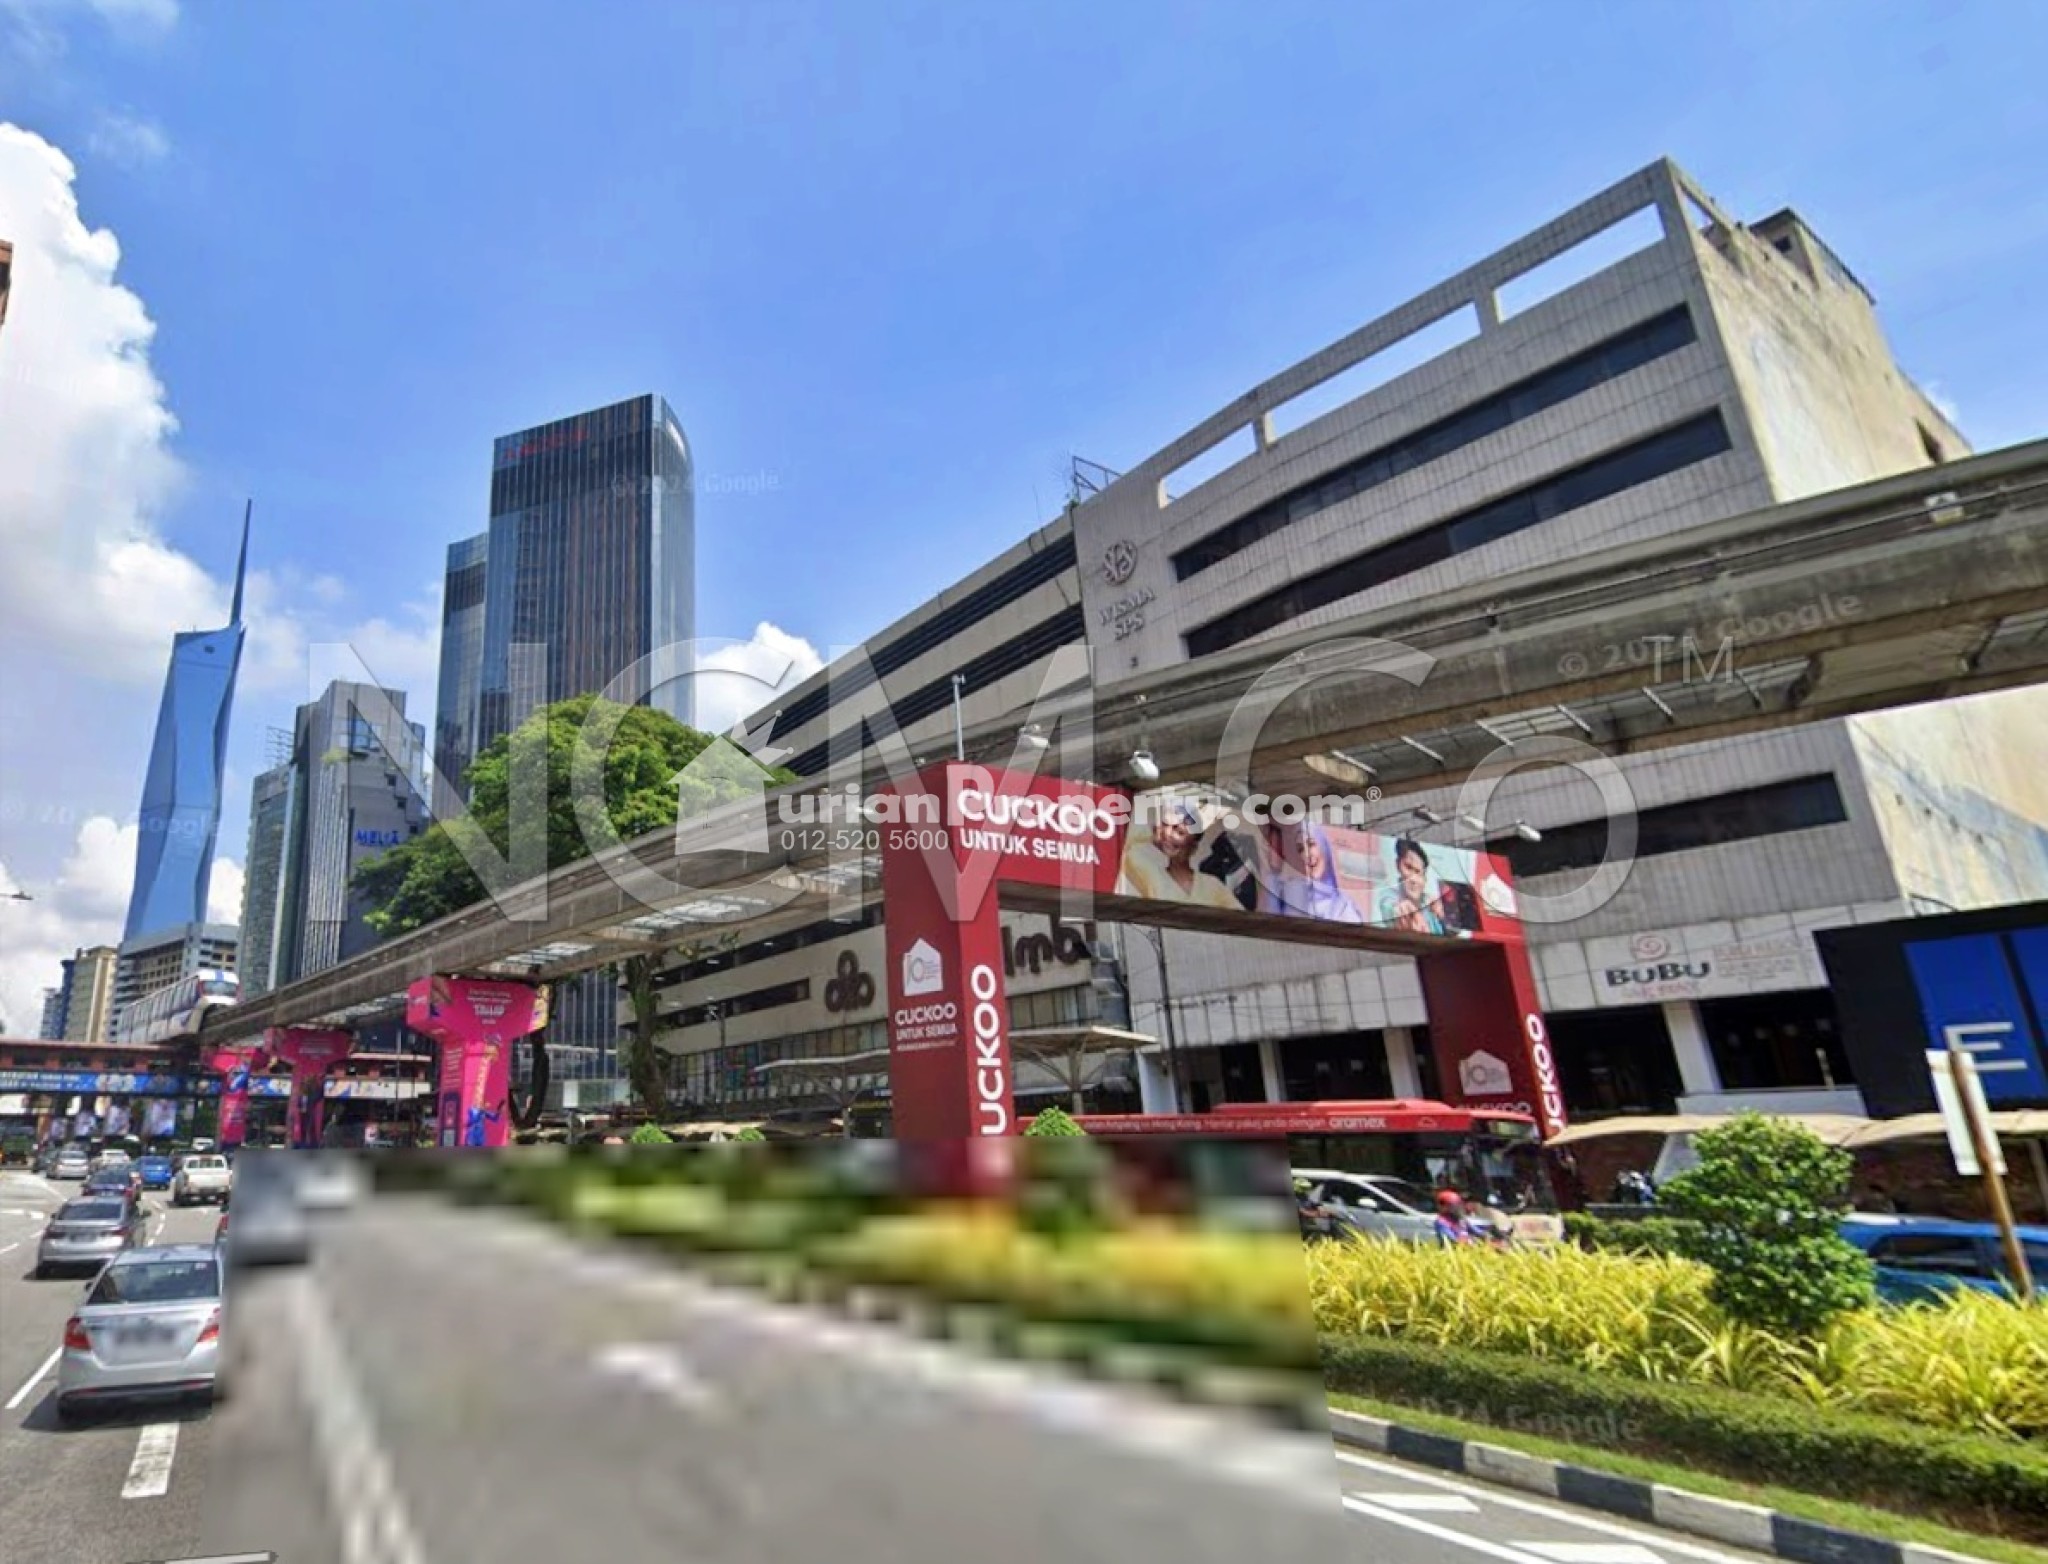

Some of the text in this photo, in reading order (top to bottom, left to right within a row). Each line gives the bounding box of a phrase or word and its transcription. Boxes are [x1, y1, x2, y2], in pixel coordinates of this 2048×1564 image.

[957, 789, 1116, 840] CUCKOO
[960, 827, 1100, 865] UNTUK SEMUA
[895, 1002, 957, 1026] CUCKOO
[970, 964, 1008, 1135] UCKOO
[1526, 1013, 1564, 1129] CKOO
